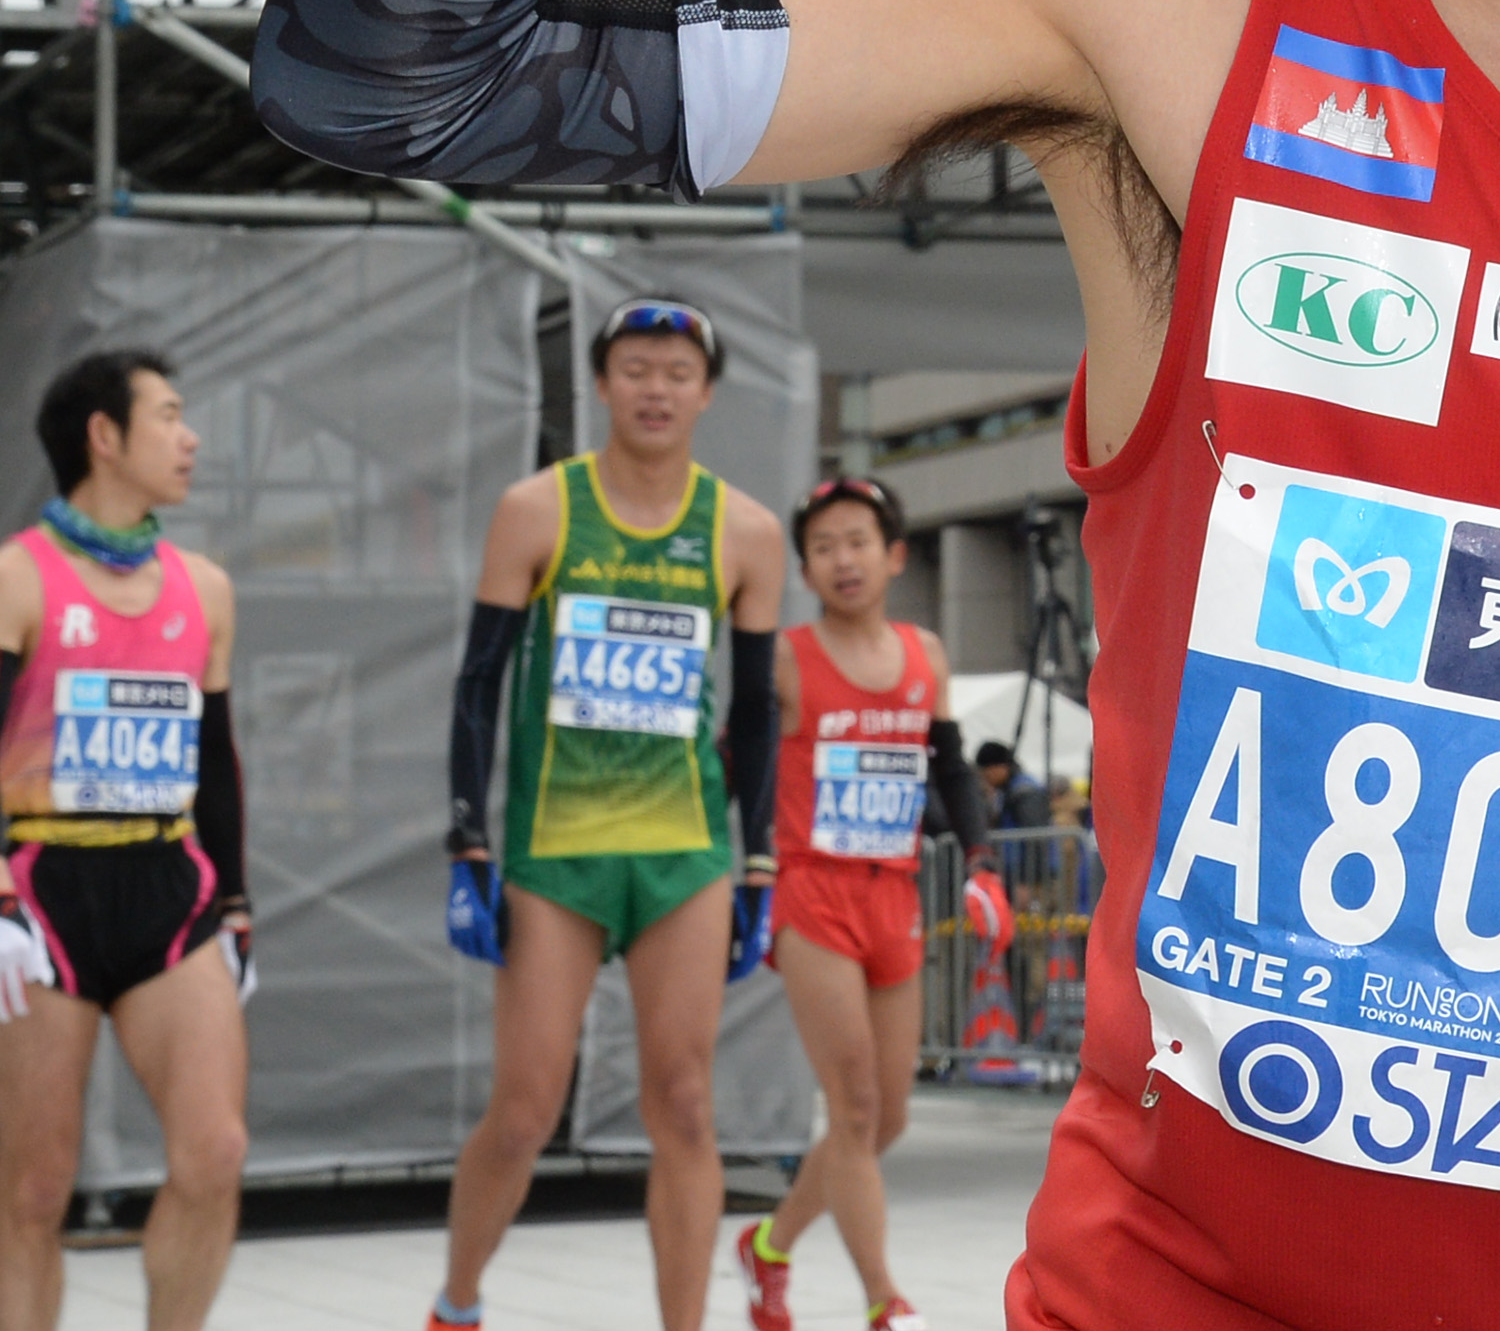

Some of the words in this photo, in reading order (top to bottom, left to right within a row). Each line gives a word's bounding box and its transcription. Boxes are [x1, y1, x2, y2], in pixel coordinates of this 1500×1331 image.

[1264, 263, 1416, 356] KC
[553, 638, 685, 695] A4665
[54, 717, 182, 770] A4064
[816, 780, 916, 825] A4007
[1152, 926, 1288, 998] GATE
[1297, 965, 1332, 1008] 2
[1359, 1005, 1408, 1026] TOKYO
[1410, 1015, 1492, 1043] MARATHON
